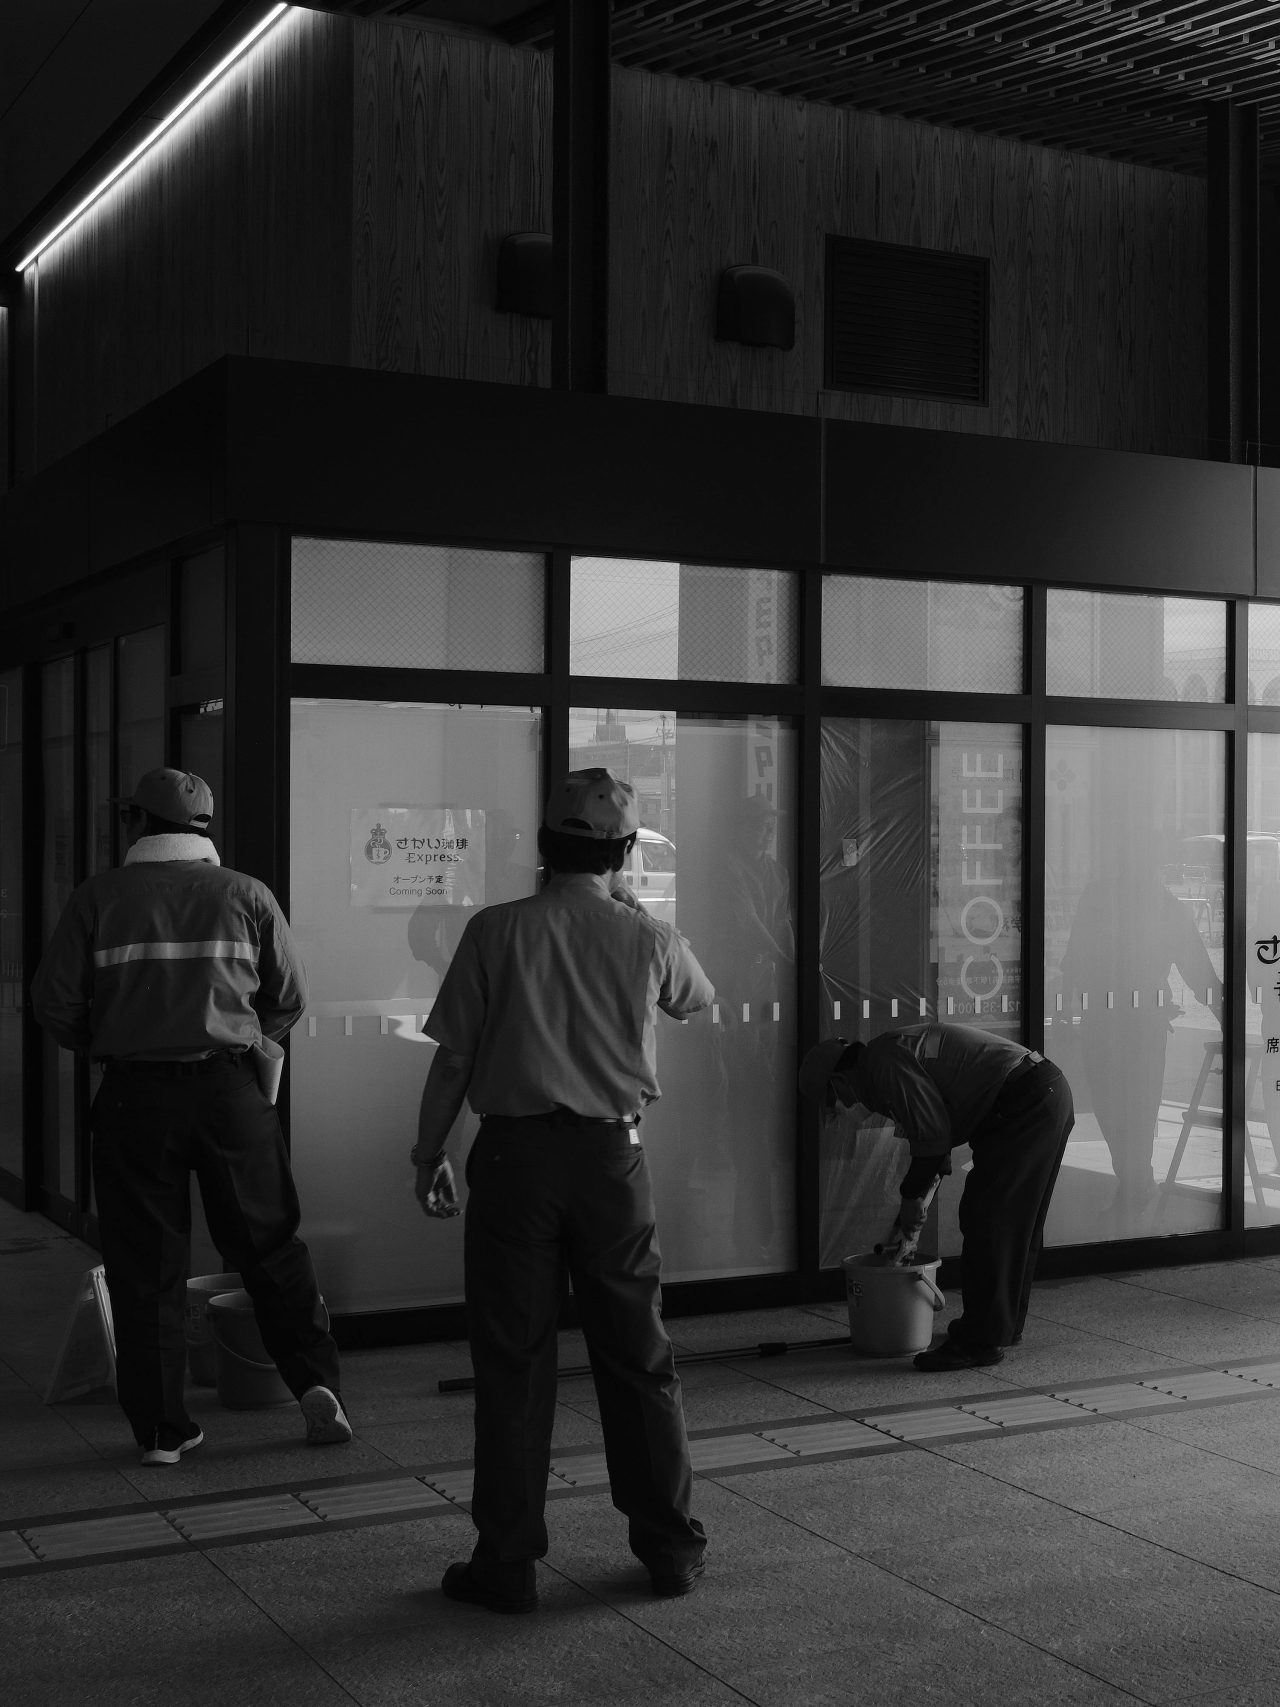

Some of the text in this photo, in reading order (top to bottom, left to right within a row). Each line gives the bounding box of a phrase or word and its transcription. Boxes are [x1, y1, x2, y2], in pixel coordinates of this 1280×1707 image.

[396, 837, 469, 850] さかい珈琲
[405, 853, 460, 864] Express
[393, 875, 444, 884] オープン予定
[961, 752, 1003, 1001] COFFEE
[389, 887, 448, 897] Coming Soon
